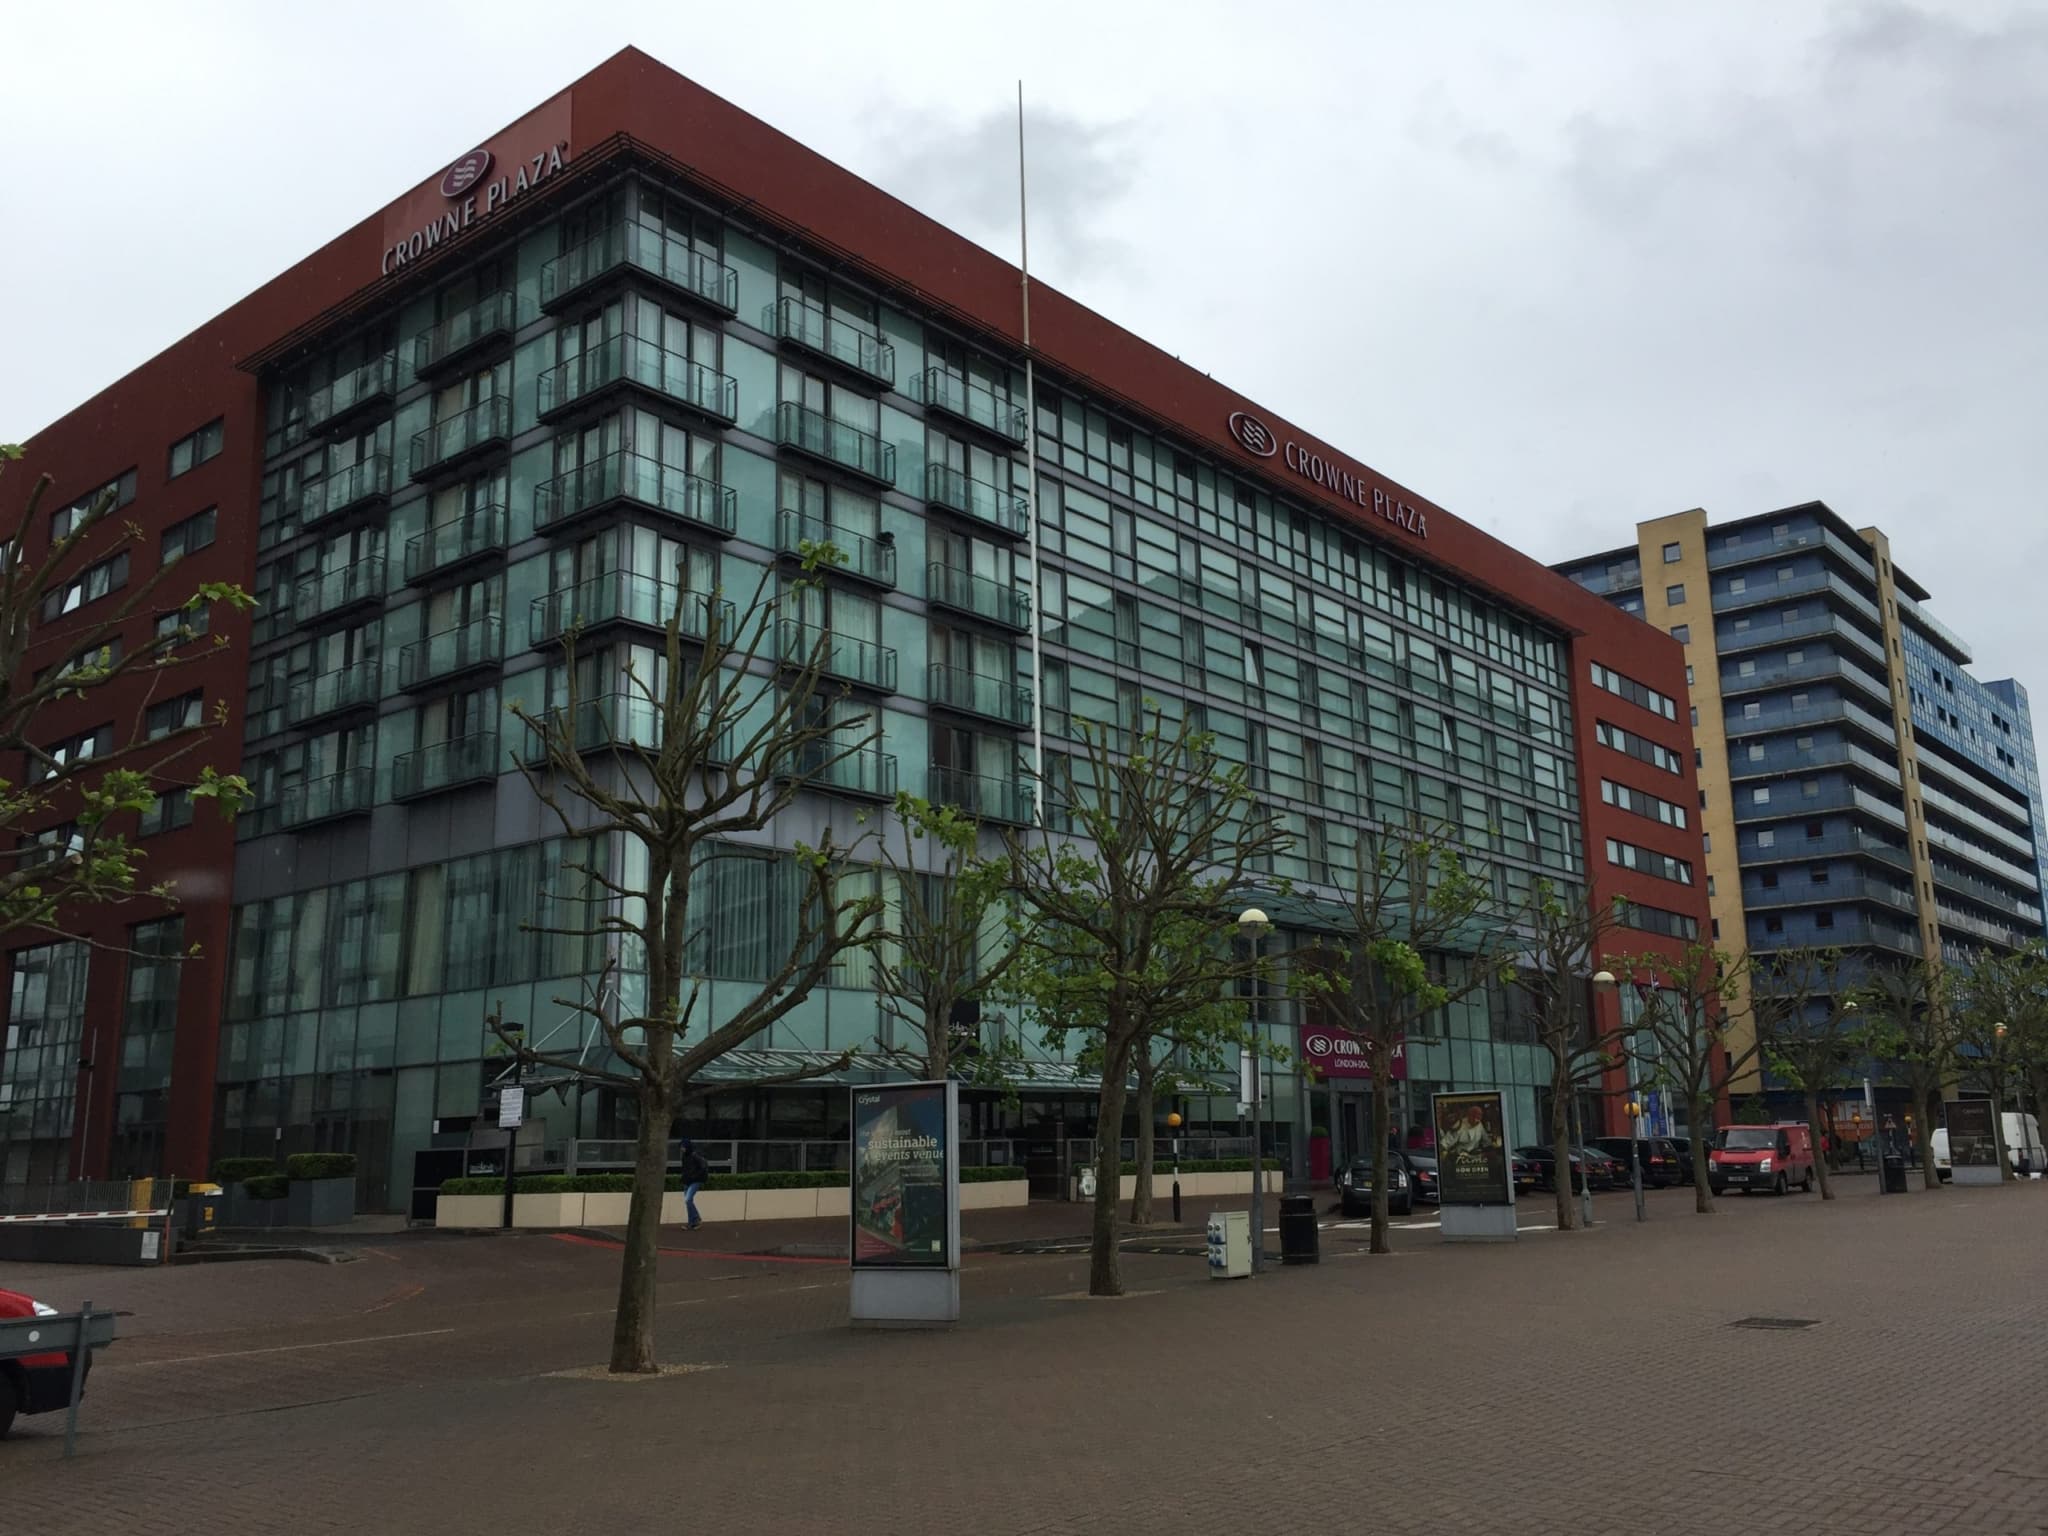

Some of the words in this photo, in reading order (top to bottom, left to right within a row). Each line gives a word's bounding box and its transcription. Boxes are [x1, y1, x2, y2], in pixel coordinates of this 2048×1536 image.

[381, 196, 476, 276] CROWNE
[487, 143, 563, 212] PLAZA
[1285, 440, 1367, 507] CROWNE
[1373, 486, 1428, 539] PLAZA
[1333, 1039, 1373, 1056] CROWE
[858, 1095, 881, 1105] Crystal
[867, 1135, 938, 1150] sustainable
[876, 1149, 911, 1161] events
